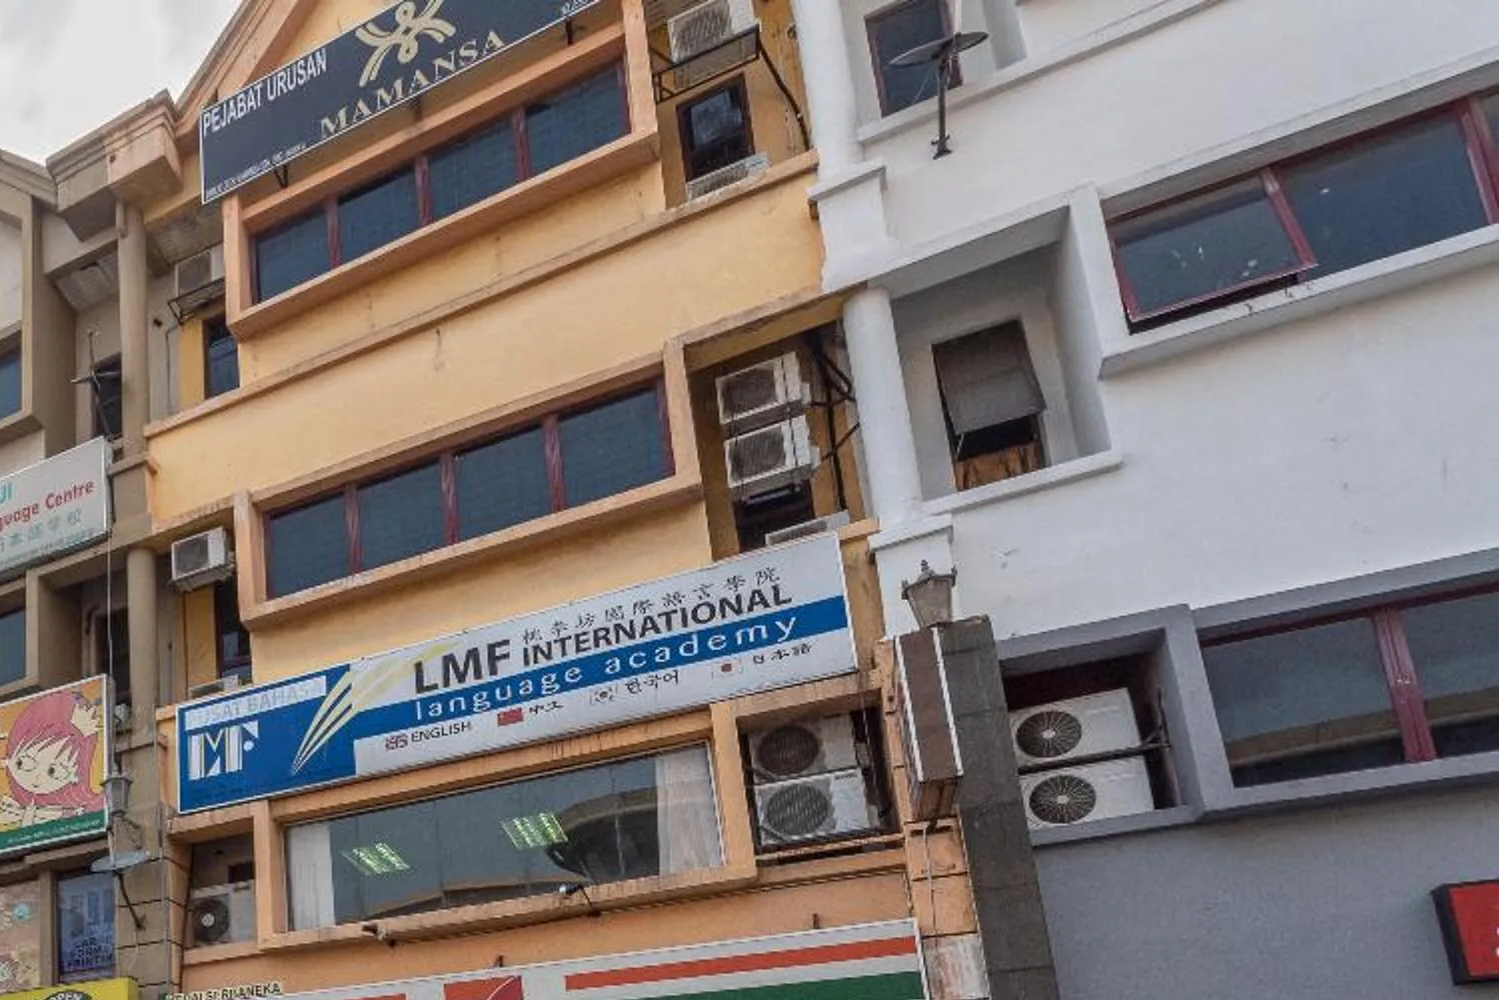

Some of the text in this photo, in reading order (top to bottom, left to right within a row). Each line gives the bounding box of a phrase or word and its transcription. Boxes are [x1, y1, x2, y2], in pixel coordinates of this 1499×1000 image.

[203, 49, 327, 136] PEJABAT URUSAN
[319, 30, 506, 139] MAMANSA
[45, 480, 94, 508] Centre
[415, 584, 792, 694] LMF INTERNATIONAL
[415, 616, 796, 720] language academy
[411, 721, 472, 744] ENGLISH
